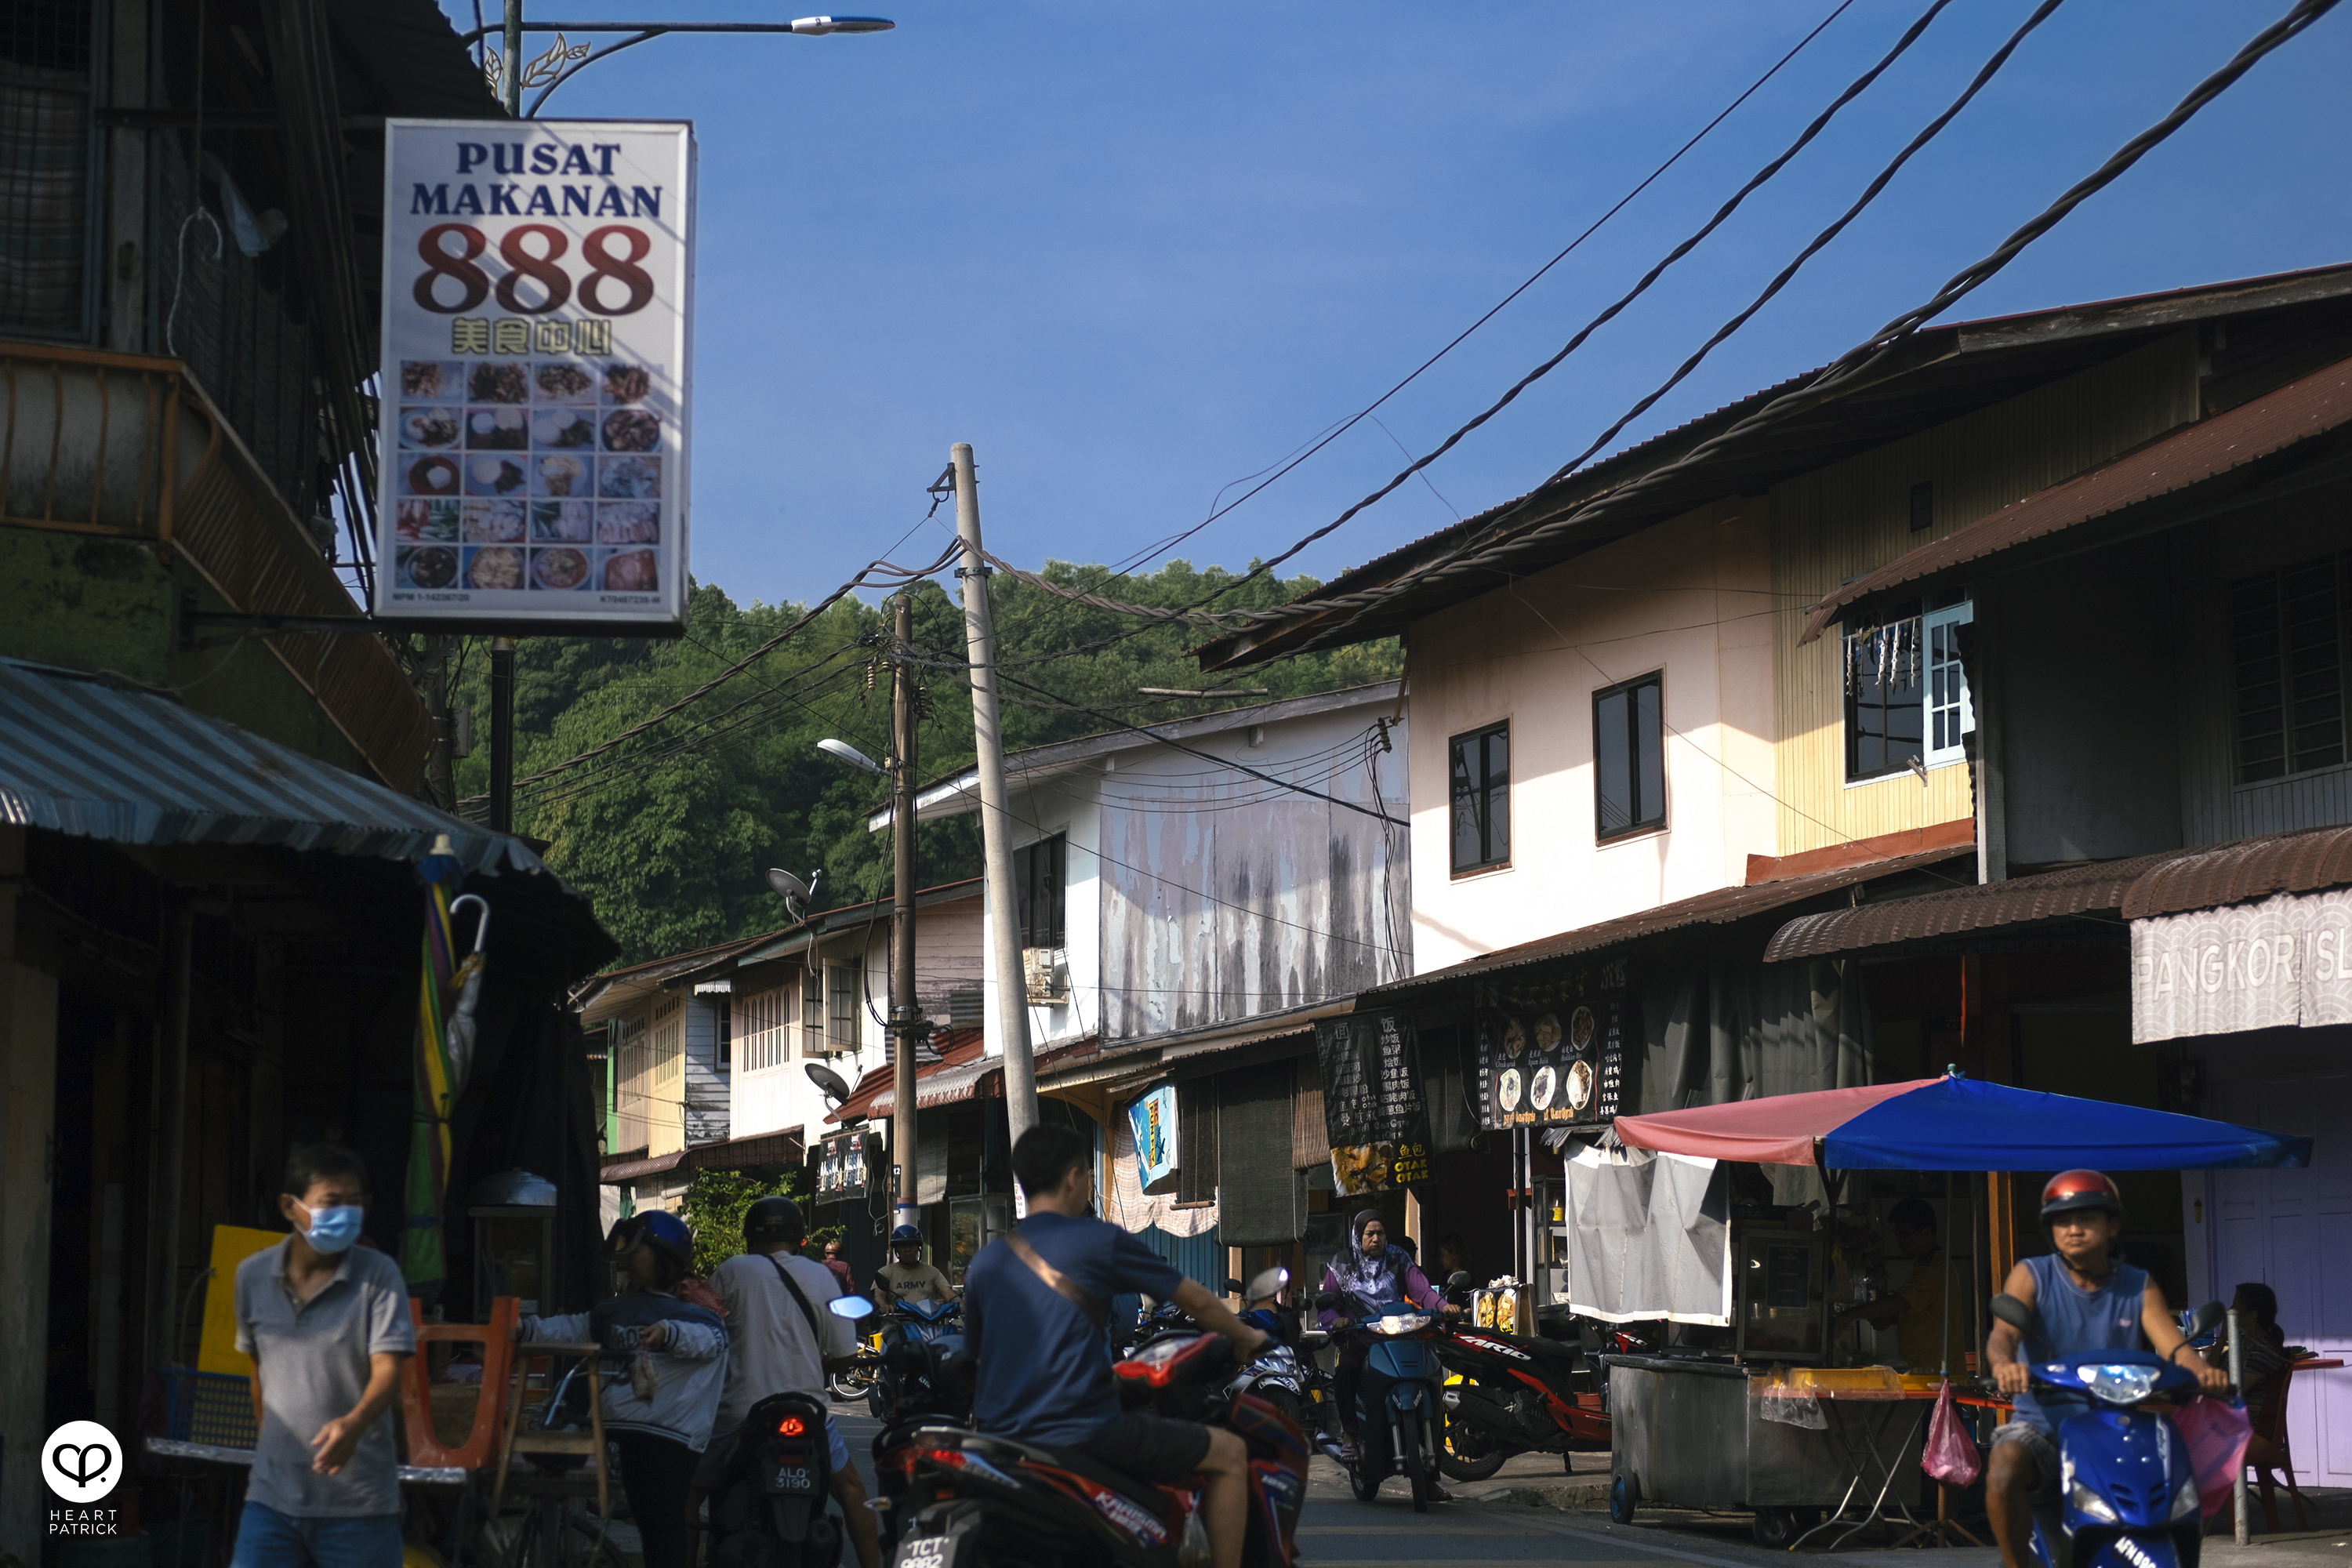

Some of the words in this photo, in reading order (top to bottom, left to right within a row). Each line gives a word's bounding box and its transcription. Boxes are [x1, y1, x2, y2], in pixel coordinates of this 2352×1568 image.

[456, 142, 621, 176] PUSAT
[410, 183, 662, 217] MAKANAN
[412, 223, 655, 315] 888
[451, 318, 612, 356] 美食中心
[2135, 934, 2297, 1004] PANGKOR
[1334, 1022, 1349, 1040] 面
[1381, 1016, 1396, 1033] 饭
[1381, 1033, 1400, 1045] 炒饭
[1382, 1044, 1401, 1056] 鱼粥
[1154, 1102, 1158, 1121] RC
[1398, 1142, 1426, 1160] 鱼包
[1394, 1158, 1428, 1172] OTAK
[1396, 1170, 1428, 1183] OTAK
[896, 1280, 926, 1290] ARMY
[775, 1478, 811, 1489] 3190
[1094, 1491, 1167, 1539] KARISMA
[911, 1536, 945, 1557] TCT
